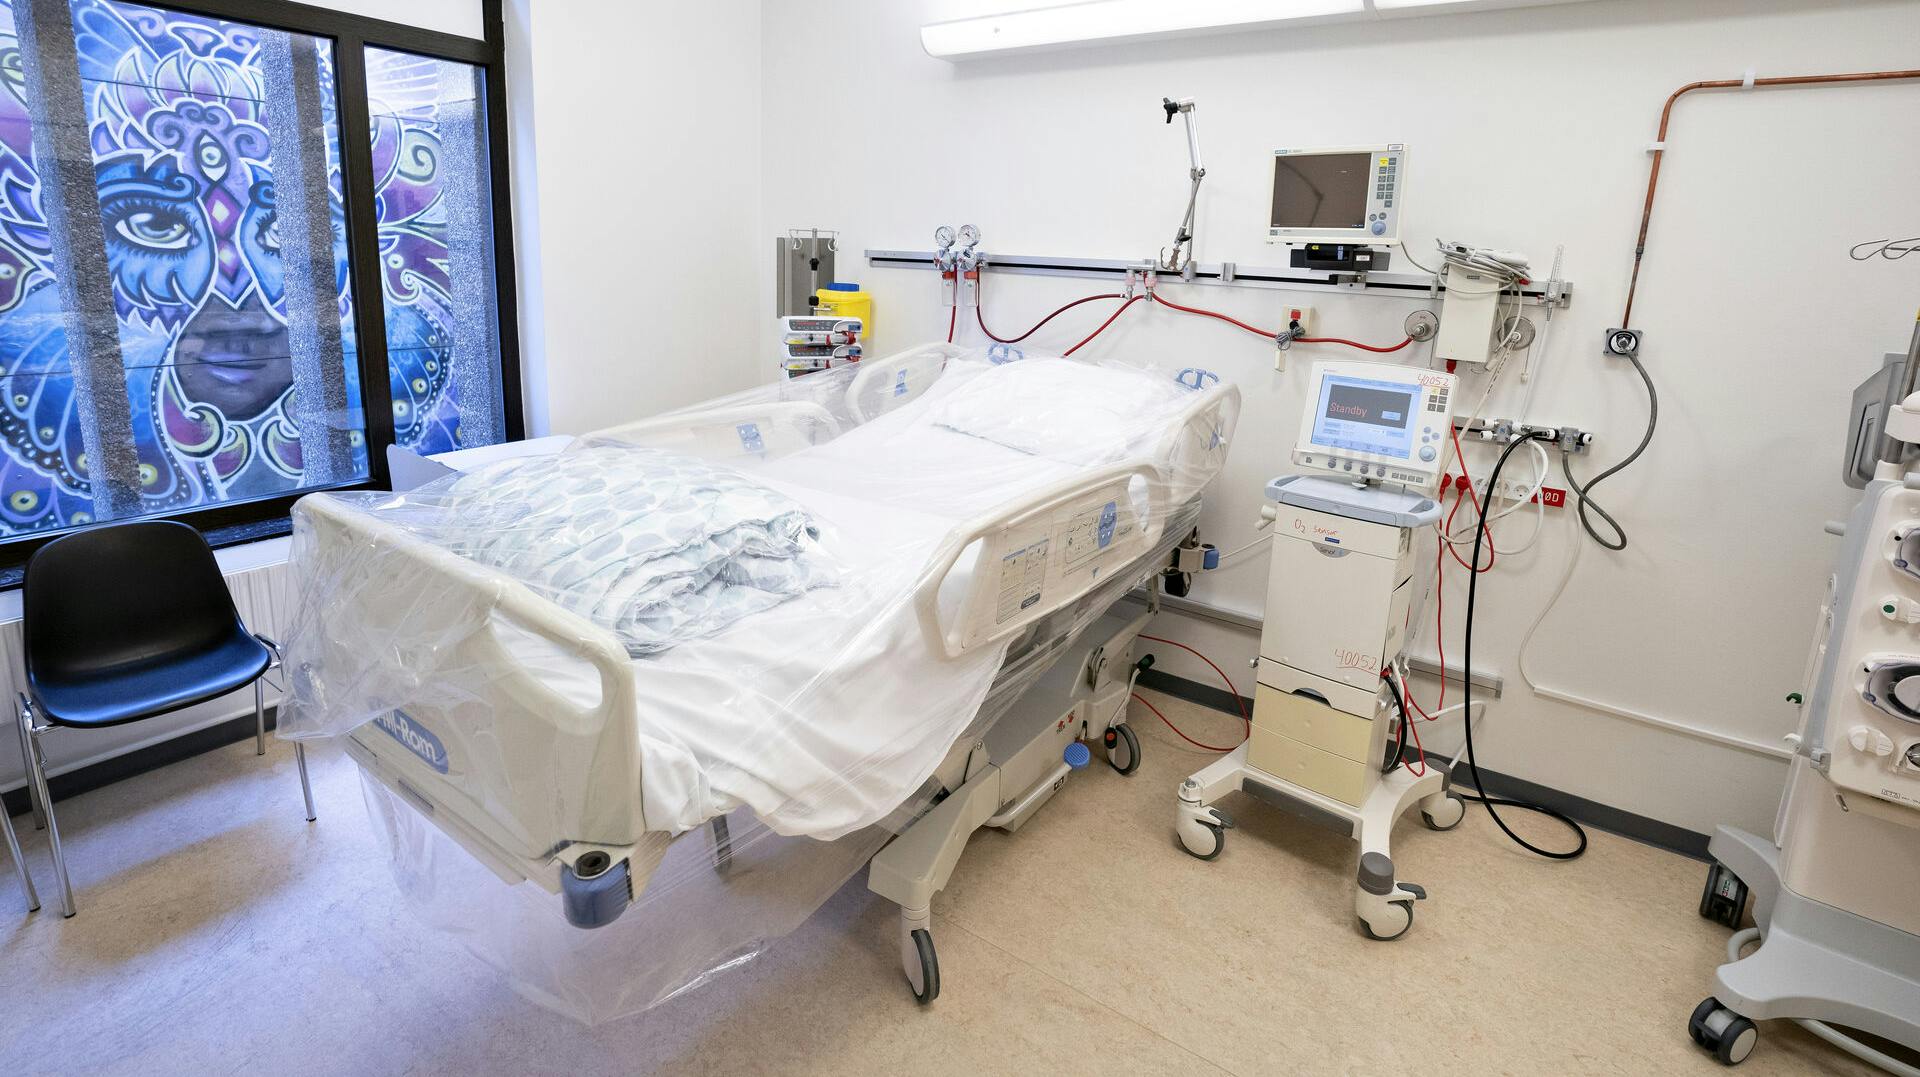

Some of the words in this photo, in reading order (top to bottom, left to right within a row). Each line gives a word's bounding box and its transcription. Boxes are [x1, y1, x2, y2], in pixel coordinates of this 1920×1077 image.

[1417, 373, 1449, 387] 40052
[1329, 402, 1368, 417] Standby
[1334, 648, 1377, 670] 40052
